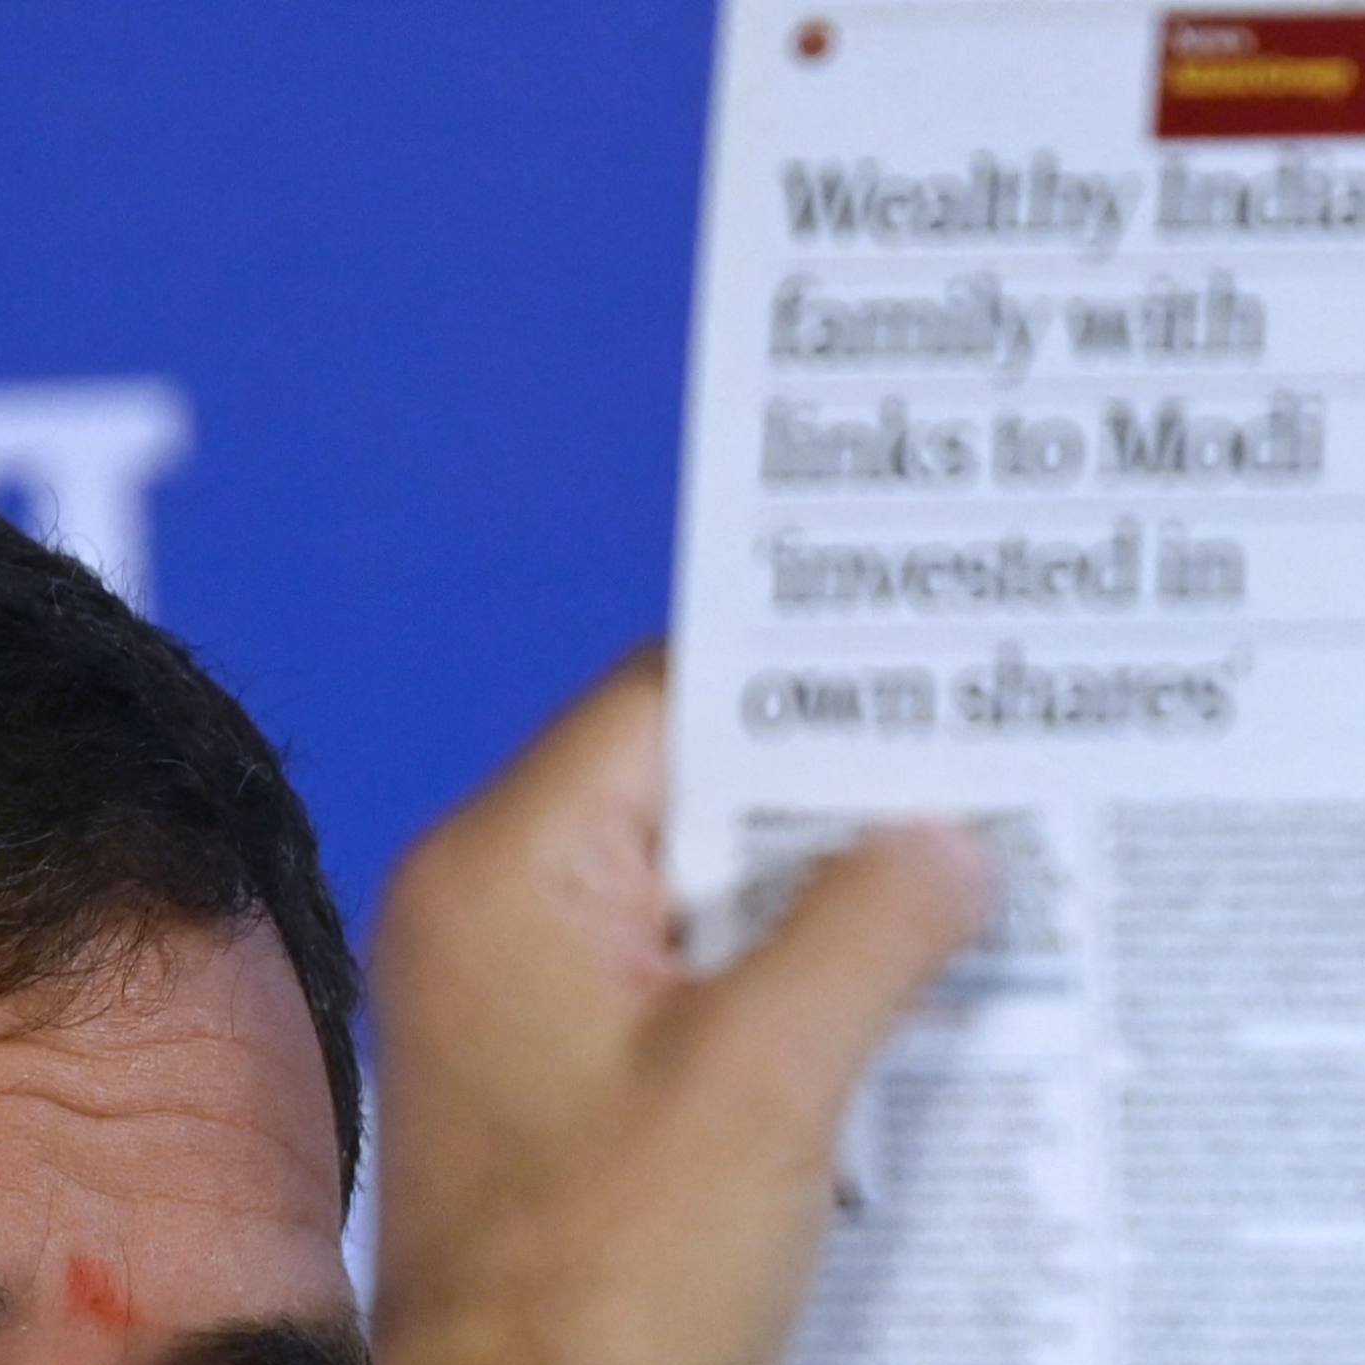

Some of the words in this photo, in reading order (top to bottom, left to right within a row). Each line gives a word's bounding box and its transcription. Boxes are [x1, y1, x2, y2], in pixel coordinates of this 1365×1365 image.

[782, 150, 1144, 266] Wealthy
[767, 272, 1052, 389] family
[1064, 269, 1268, 362] with
[758, 395, 979, 490] links
[990, 406, 1088, 489] to
[1095, 390, 1327, 487] Modi
[1155, 518, 1248, 610] in
[739, 664, 940, 740] own
